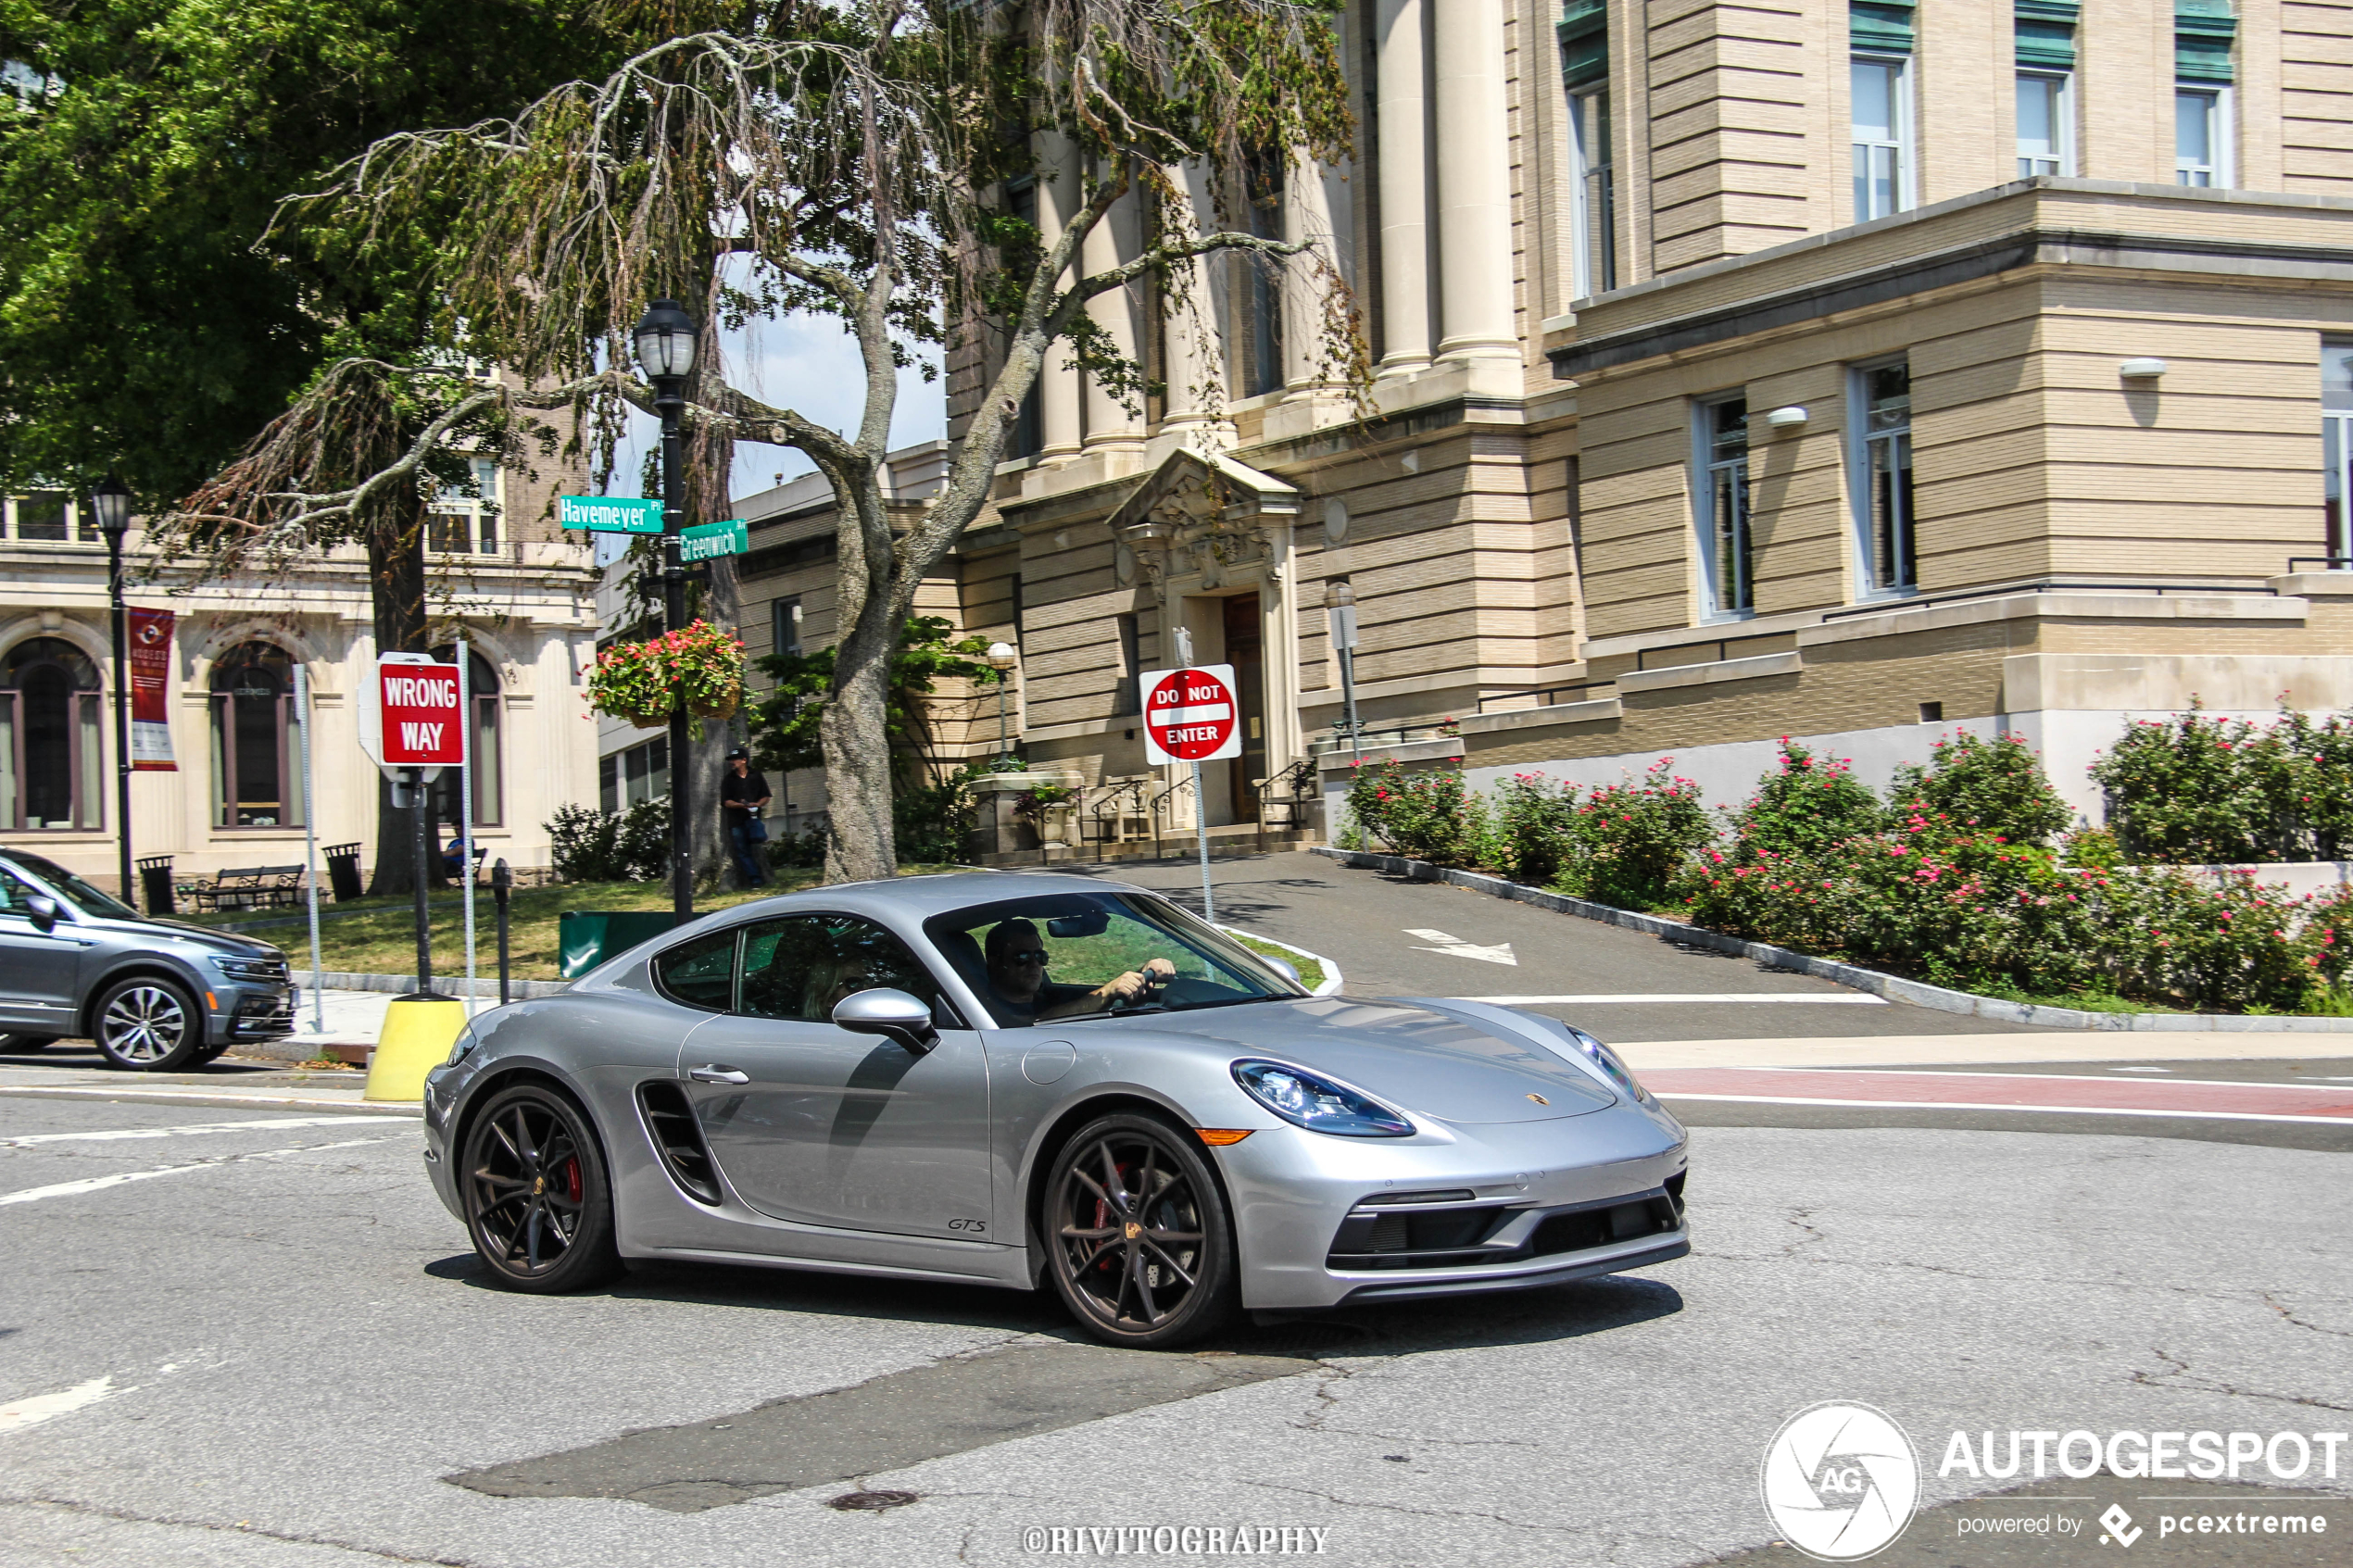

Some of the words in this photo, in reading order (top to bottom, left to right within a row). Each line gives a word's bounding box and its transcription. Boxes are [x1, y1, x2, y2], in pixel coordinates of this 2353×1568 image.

[561, 498, 647, 529] Havemeyer
[680, 529, 736, 561] Greenwich
[384, 677, 457, 709] WRONG
[1155, 689, 1179, 705] DO
[1188, 684, 1221, 701] NOT
[400, 721, 445, 751] WAY
[1165, 726, 1218, 744] ENTER
[948, 1218, 987, 1233] GTS
